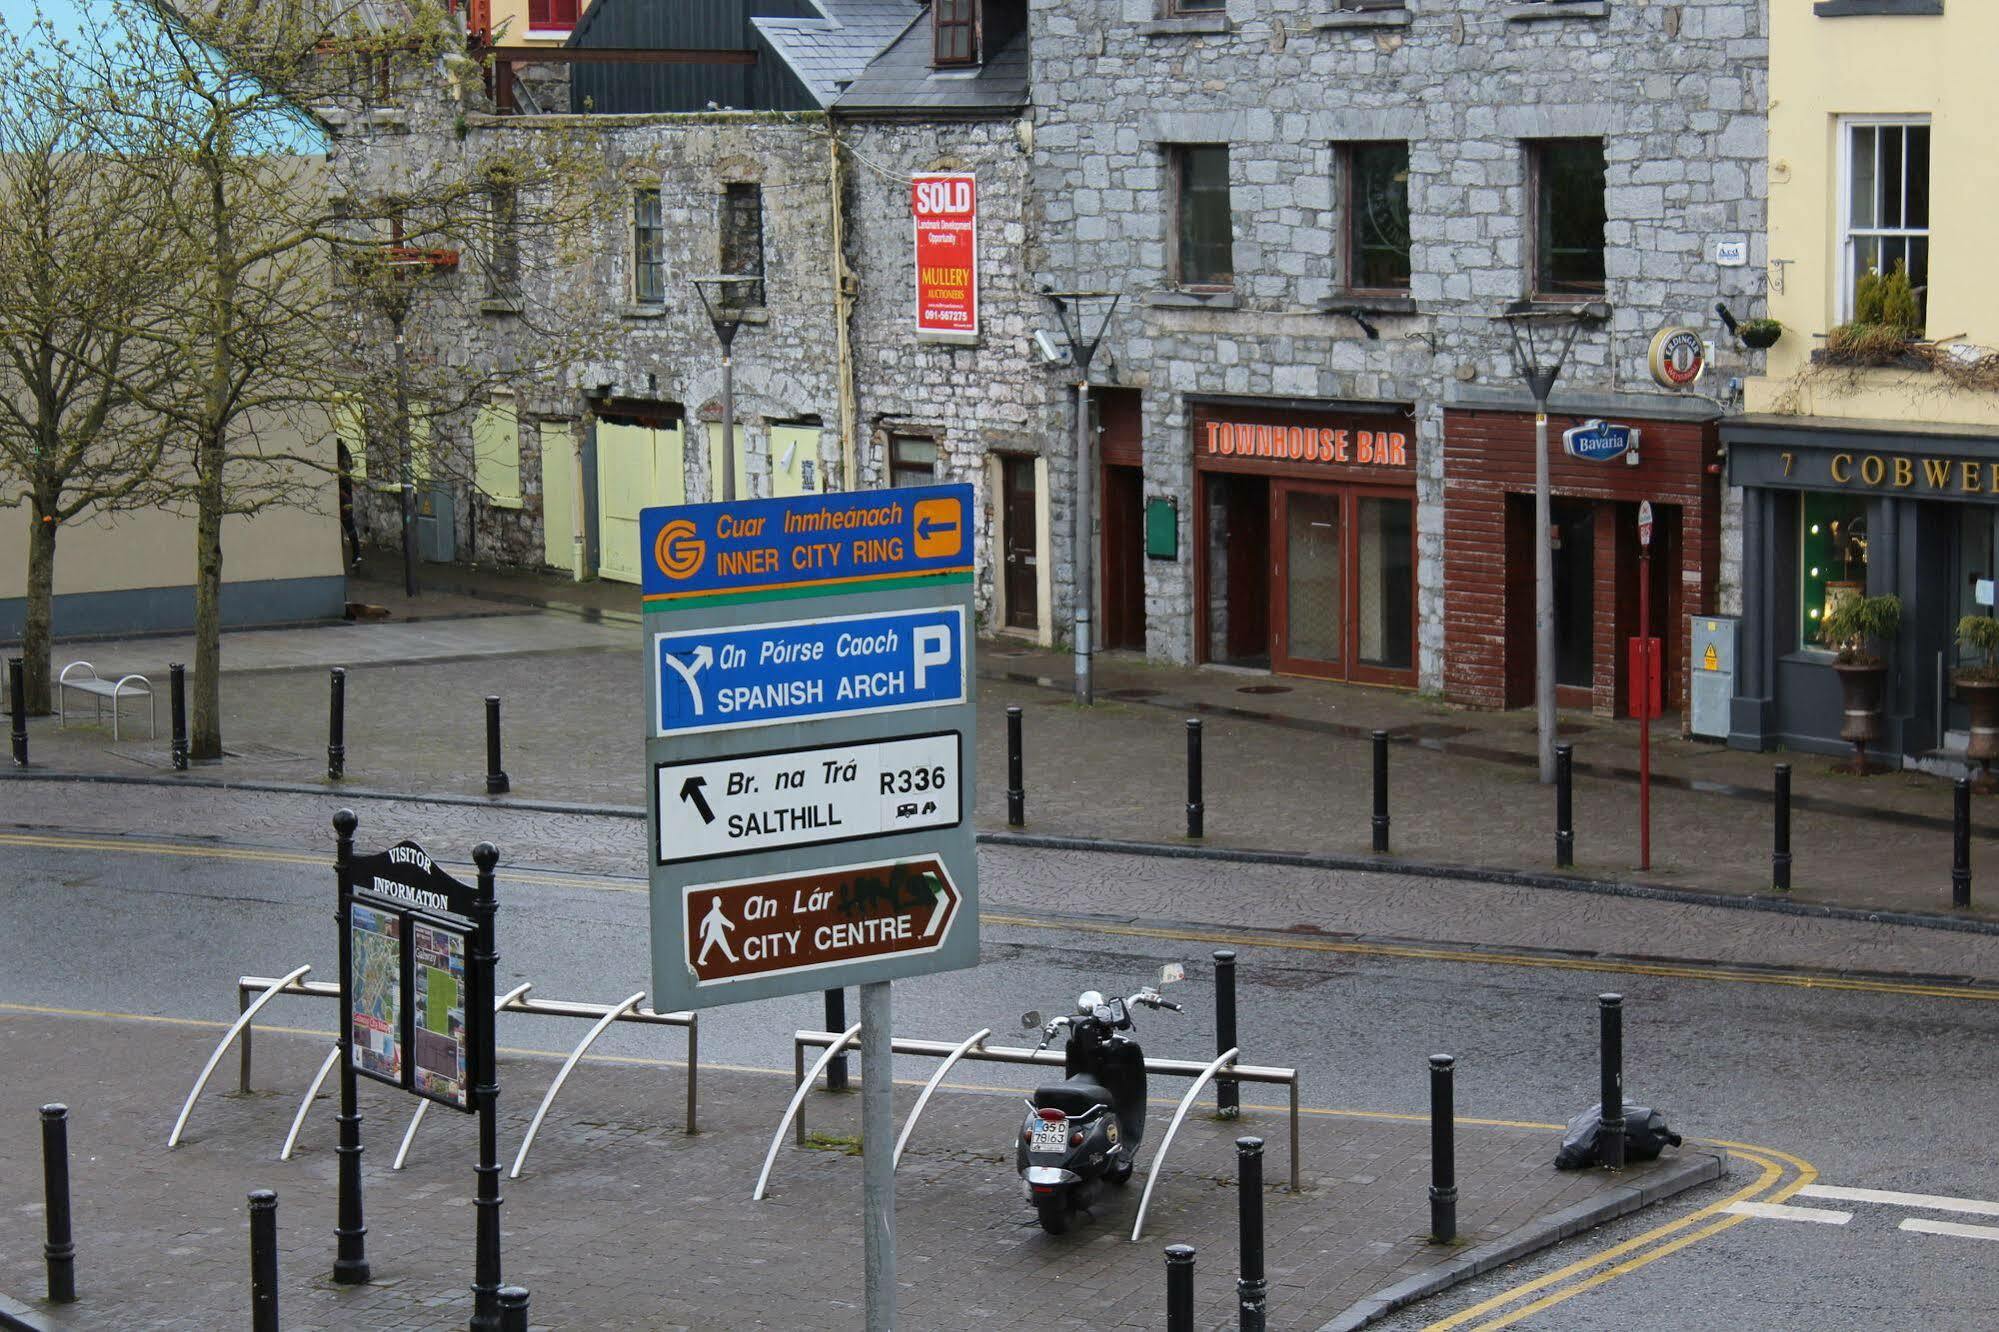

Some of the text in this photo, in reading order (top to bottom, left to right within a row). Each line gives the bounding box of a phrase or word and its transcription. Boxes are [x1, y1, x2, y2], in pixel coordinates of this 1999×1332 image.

[917, 182, 970, 214] SOLD
[928, 232, 956, 246] Opportunity
[922, 267, 969, 286] MULLERY
[1665, 334, 1700, 356] ERDINGER
[1206, 422, 1406, 465] TOWNHOUSE BAR
[1579, 434, 1624, 452] Bavaria
[1781, 453, 1792, 477] 7
[716, 501, 904, 539] Cuar Inmheánach
[717, 537, 904, 576] INNER CITY RING
[719, 644, 746, 669] An
[836, 629, 898, 658] Caoch
[913, 624, 951, 690] P
[717, 671, 905, 713] SPANISH ARCH
[727, 758, 858, 796] Br. na Trá
[880, 766, 946, 795] R336
[727, 803, 842, 838] SALTHILL
[388, 846, 432, 875] VISITOR
[373, 875, 449, 911] INFORMATION
[743, 895, 778, 920] An
[792, 886, 834, 914] Lár
[743, 914, 912, 961] CITY CENTRE
